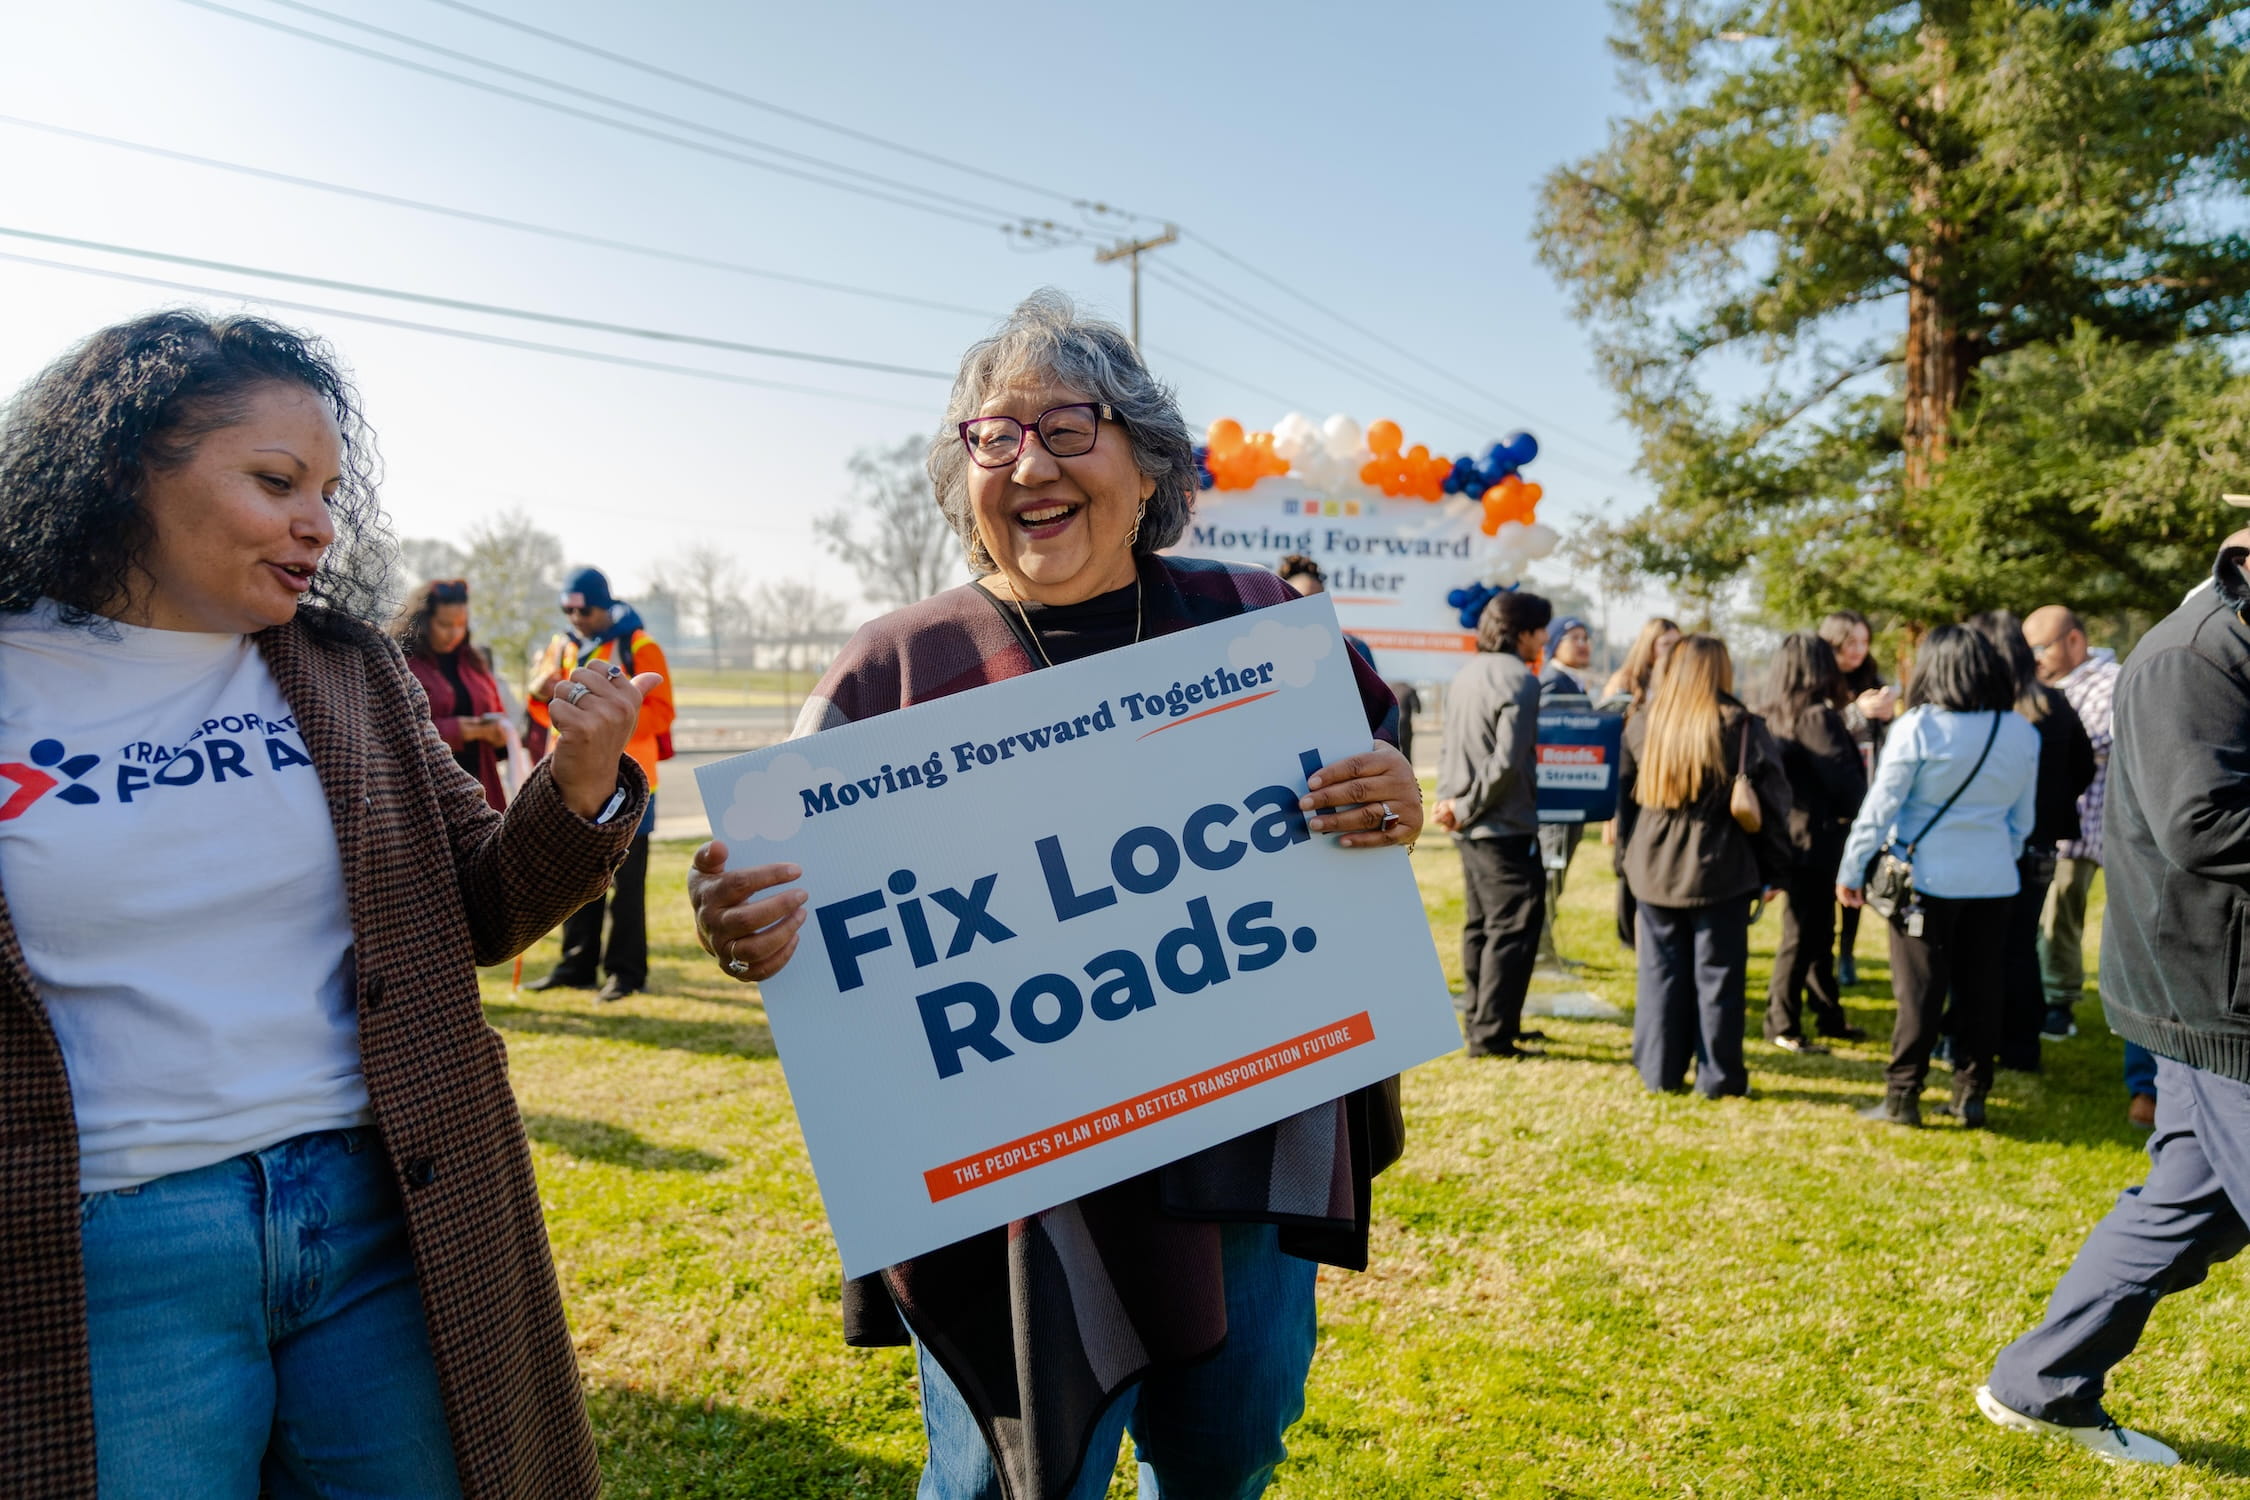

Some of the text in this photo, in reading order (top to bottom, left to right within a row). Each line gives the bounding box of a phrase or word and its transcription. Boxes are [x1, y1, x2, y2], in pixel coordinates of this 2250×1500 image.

[1190, 525, 1471, 558] Moving Forward
[116, 738, 254, 803] FOR
[798, 661, 1275, 818] Moving Forward Together
[814, 869, 1018, 994] Fix
[914, 895, 1318, 1081] Roads.
[953, 1025, 1353, 1186] THE PEOPLE'S PLAN FOR A BETTER TRANSPORTATION FUTURE
